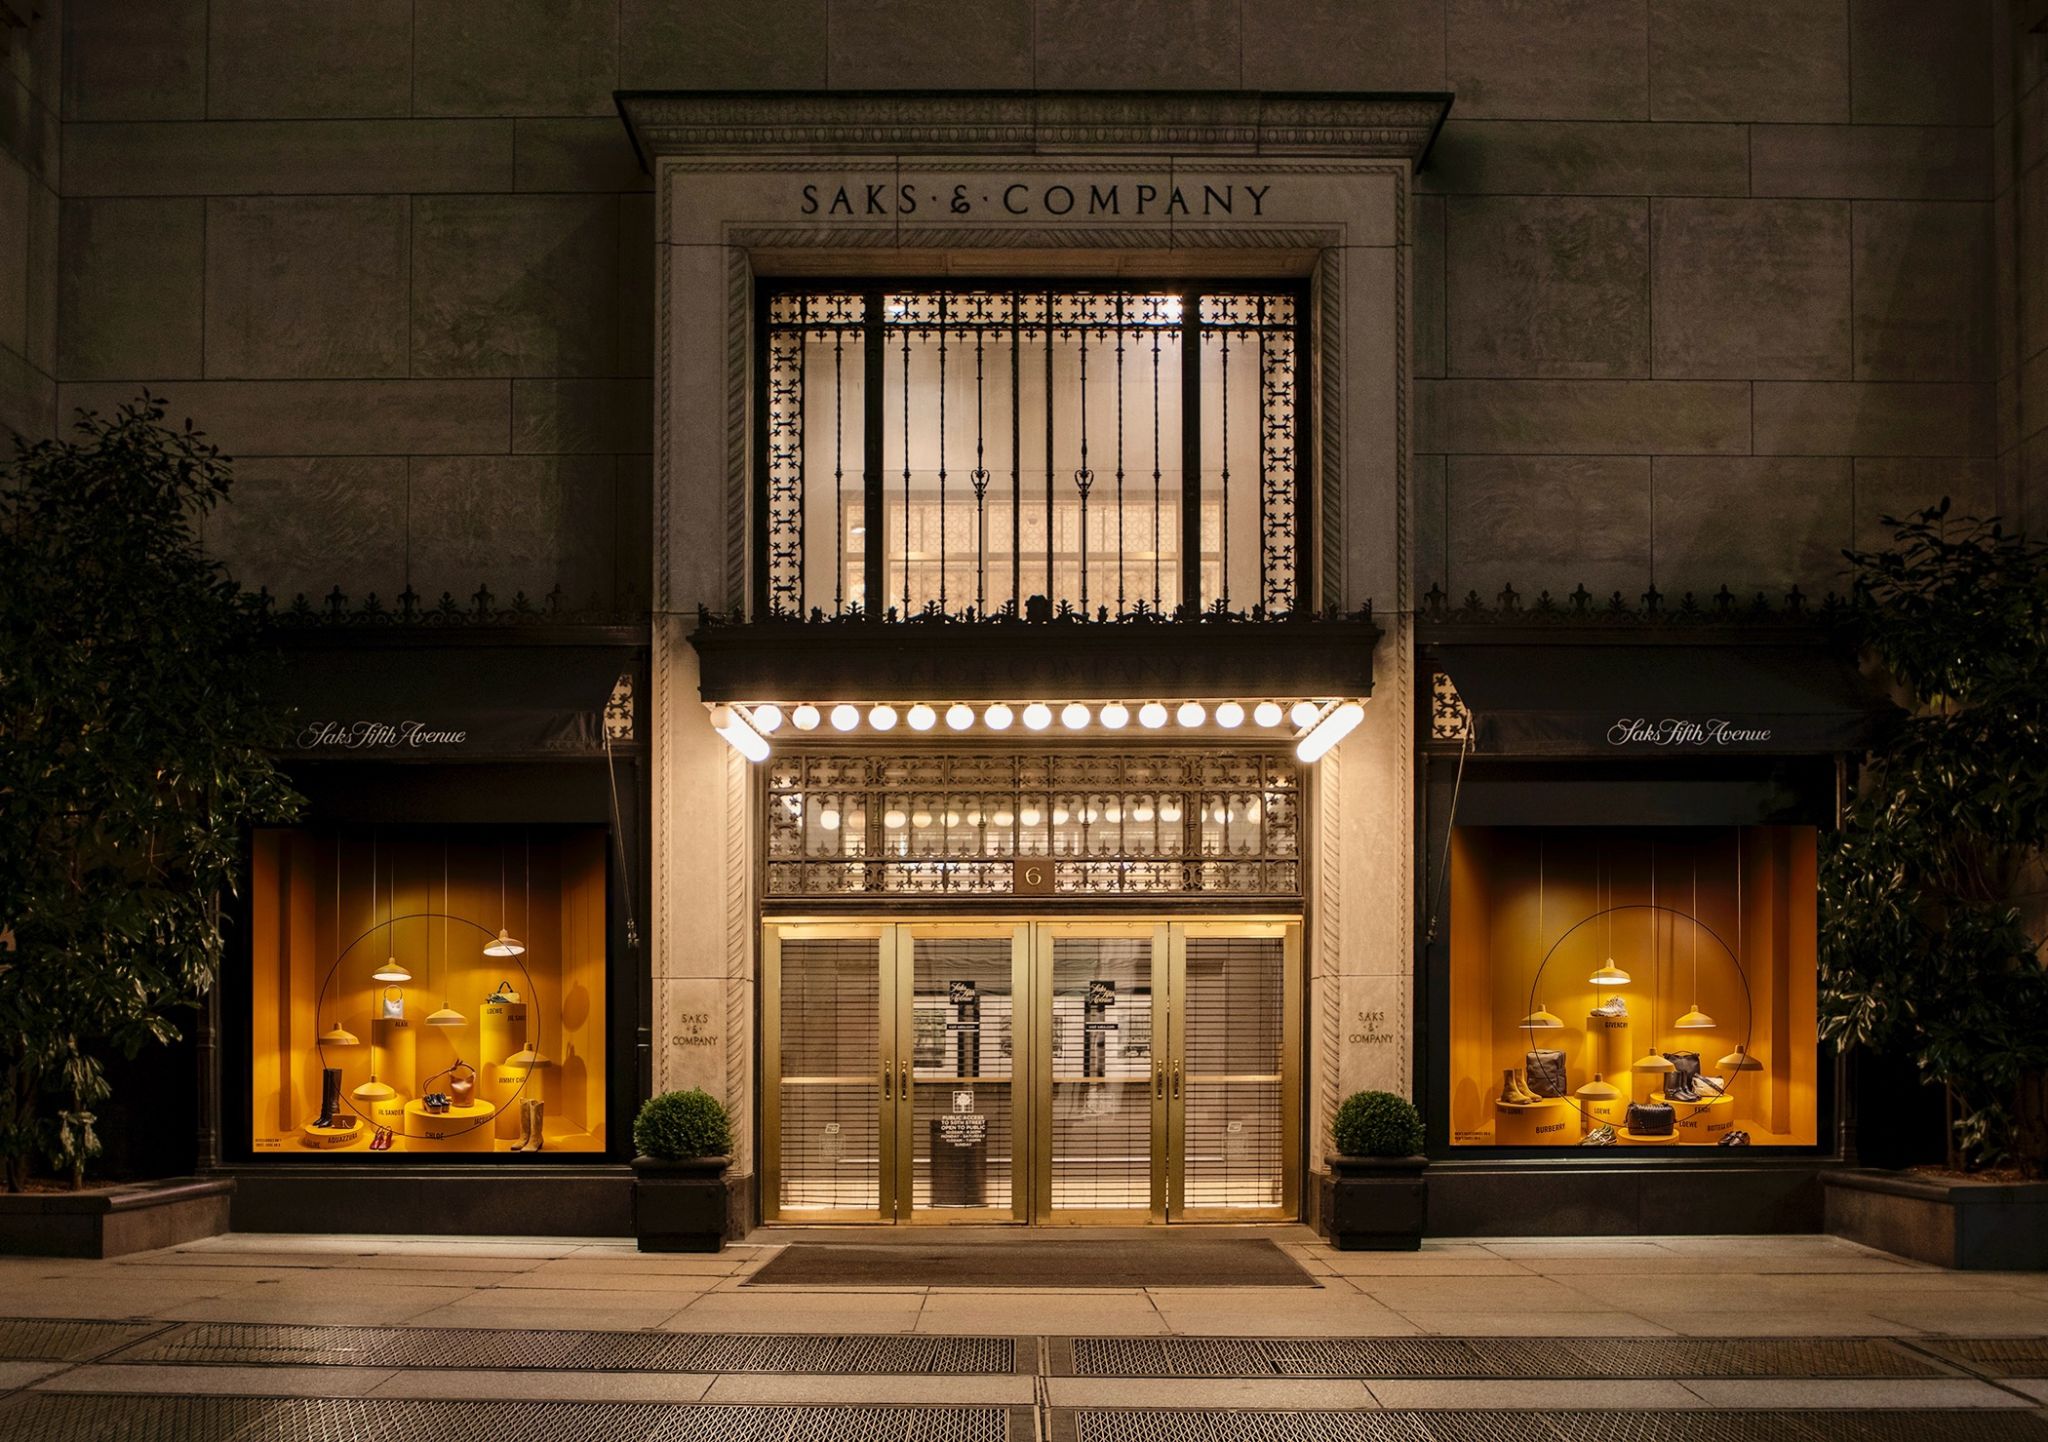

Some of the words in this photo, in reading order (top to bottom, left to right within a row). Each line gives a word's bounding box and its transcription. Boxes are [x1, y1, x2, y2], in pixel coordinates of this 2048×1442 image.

[801, 184, 917, 214] SAKS
[951, 184, 971, 214] &
[1003, 184, 1271, 215] COMPANY
[297, 721, 351, 749] Saks
[345, 721, 397, 749] Fifth
[396, 720, 466, 748] Avenue
[1607, 718, 1660, 745] Saks
[1654, 718, 1703, 746] Fifth
[1702, 718, 1771, 745] Avenue
[1025, 866, 1042, 886] 6
[682, 1014, 708, 1024] SAKS
[1358, 1011, 1384, 1021] SAKS
[672, 1036, 718, 1046] COMPANY
[1349, 1034, 1394, 1044] COMPANY
[1536, 1123, 1565, 1134] BURBERRY
[328, 1133, 357, 1143] AQUAZZURA
